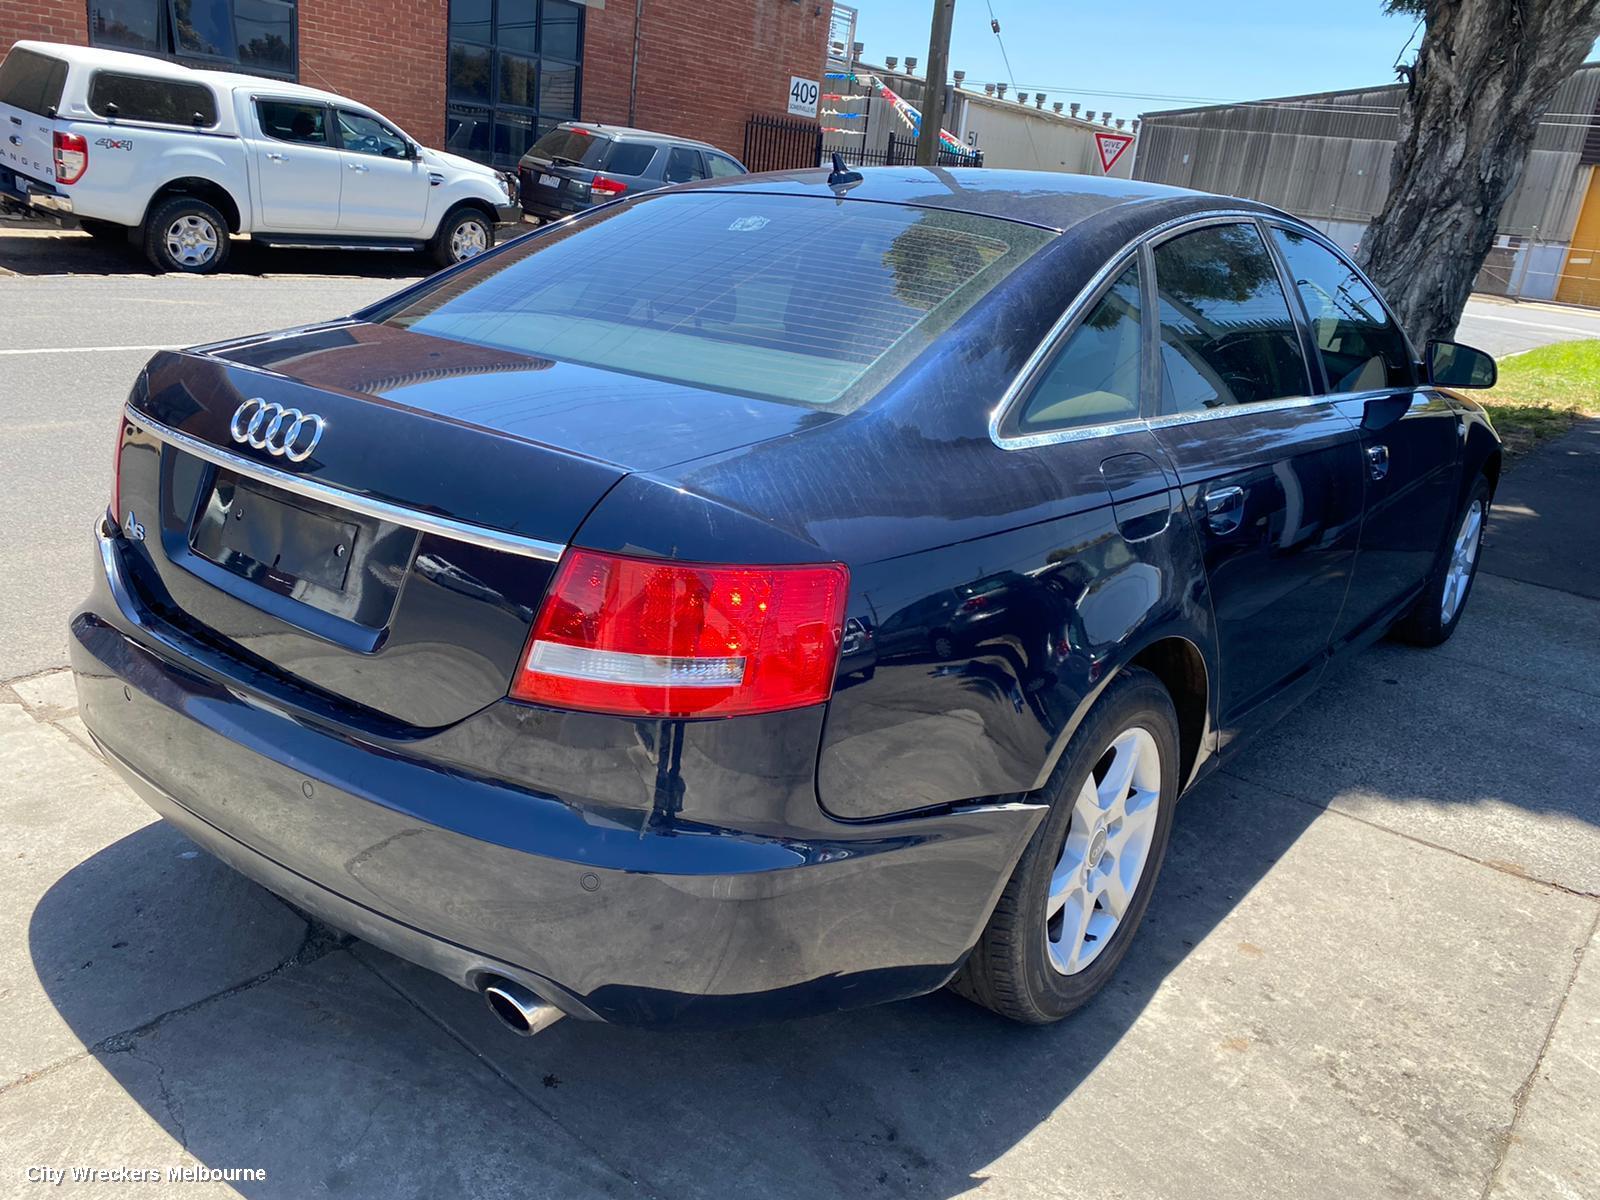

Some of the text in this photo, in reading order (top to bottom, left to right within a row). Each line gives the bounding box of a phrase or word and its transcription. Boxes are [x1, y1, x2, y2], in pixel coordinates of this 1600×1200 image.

[791, 81, 818, 105] 409
[968, 131, 978, 147] 51
[1103, 140, 1121, 149] GIVE
[124, 510, 146, 541] A6
